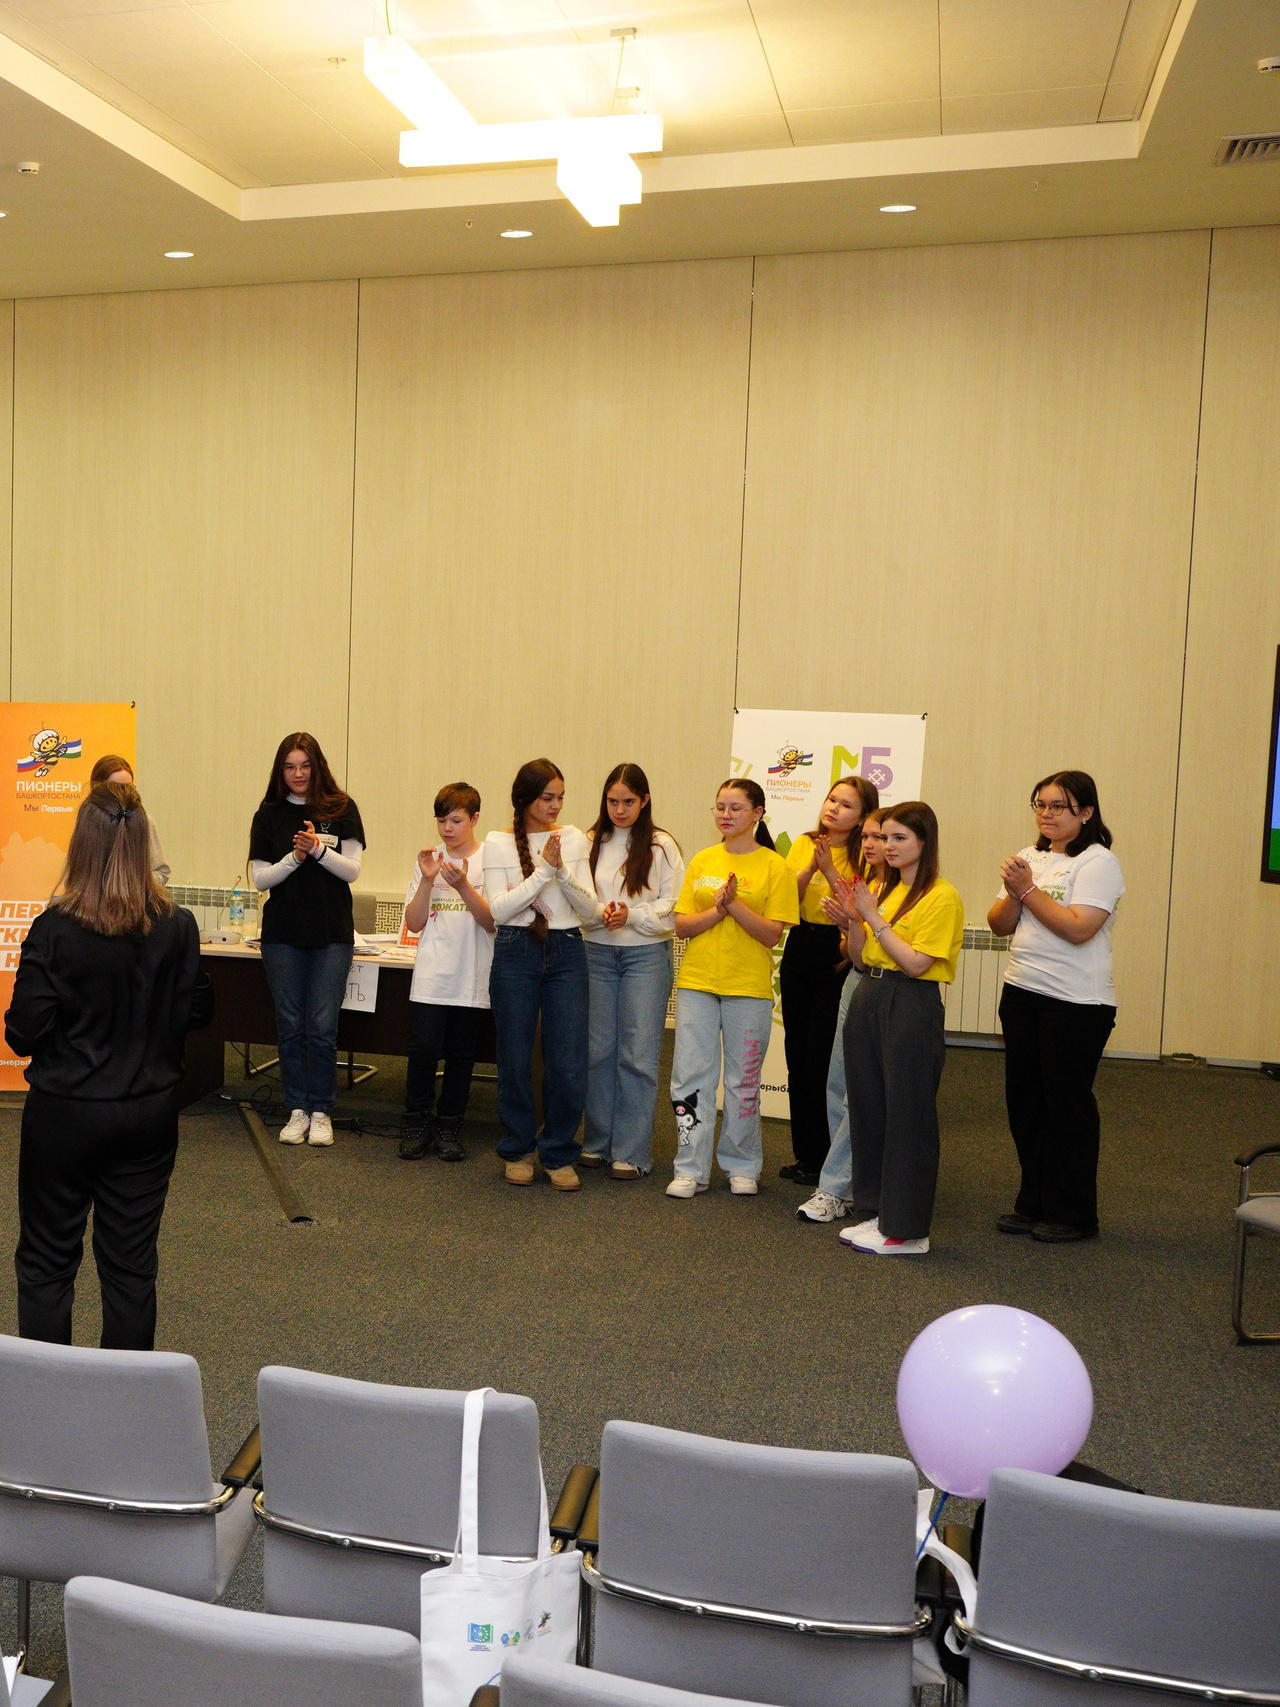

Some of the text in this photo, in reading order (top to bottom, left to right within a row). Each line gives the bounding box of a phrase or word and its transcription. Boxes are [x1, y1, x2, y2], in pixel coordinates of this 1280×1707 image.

[16, 780, 82, 792] ПИОНЕРЫ
[766, 778, 812, 789] ПИОНЕРЫ
[766, 786, 811, 794] БАШКОРТОСТАНА
[16, 792, 81, 800] БАШКОРТОСТАНА
[23, 803, 73, 815] Мы Первые
[0, 902, 49, 919] ПЕР
